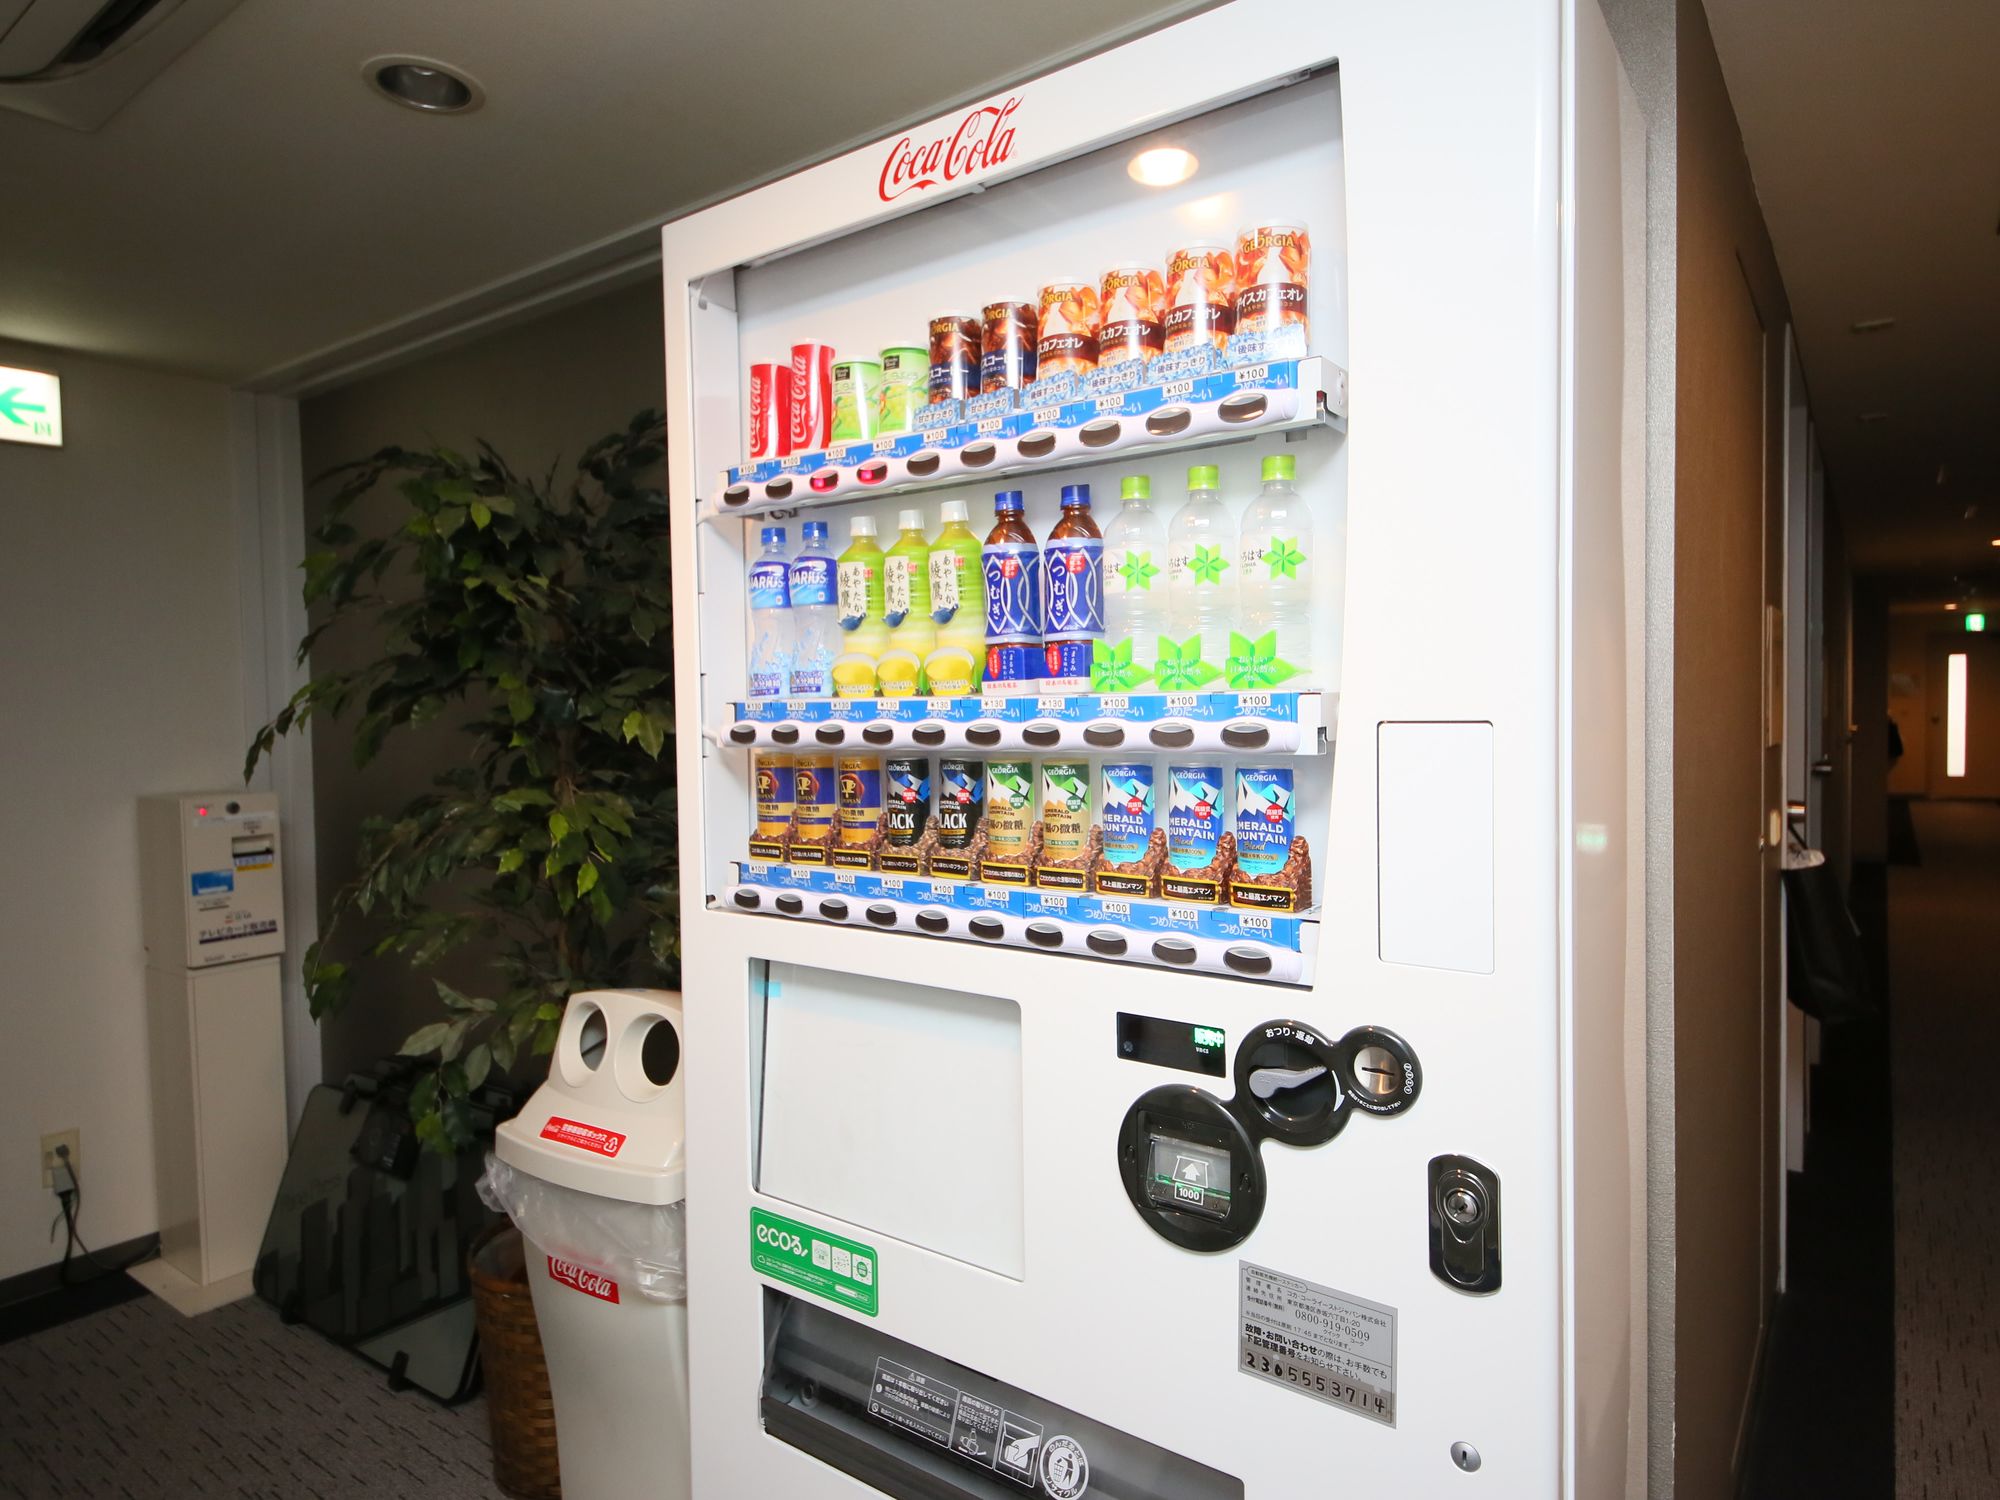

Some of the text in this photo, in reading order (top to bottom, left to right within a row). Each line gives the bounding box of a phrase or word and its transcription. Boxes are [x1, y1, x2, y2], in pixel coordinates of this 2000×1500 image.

[1239, 367, 1265, 380] ¥100
[1166, 382, 1190, 394] ¥100
[1099, 396, 1121, 407] ¥100
[1037, 409, 1058, 419] ¥100
[981, 420, 1000, 430] ¥100
[926, 430, 945, 440] ¥100
[988, 570, 1001, 620] つむぎ
[1052, 565, 1066, 617] つむぎ
[984, 699, 1004, 708] ¥130
[1042, 699, 1062, 708] ¥130
[1104, 698, 1126, 707] ¥100
[1170, 696, 1194, 705] ¥100
[1242, 695, 1267, 705] ¥100
[1108, 769, 1136, 777] GEORGIA
[1176, 770, 1206, 779] GEORGIA
[1245, 772, 1278, 781] GEORGIA
[885, 879, 901, 888] ¥100
[934, 885, 952, 894] ¥100
[988, 891, 1007, 900] ¥100
[1044, 896, 1065, 906] ¥100
[1105, 902, 1127, 913] ¥100
[1171, 909, 1195, 920] ¥100
[1243, 916, 1268, 928] ¥100
[1265, 1026, 1315, 1045] おつり・返却
[1178, 1187, 1200, 1201] 1000
[1295, 1309, 1370, 1342] 0800-919-0509
[1245, 1332, 1362, 1382] 下記管理番号をお知らせ下さい。
[1046, 1475, 1079, 1498] リサイクル
